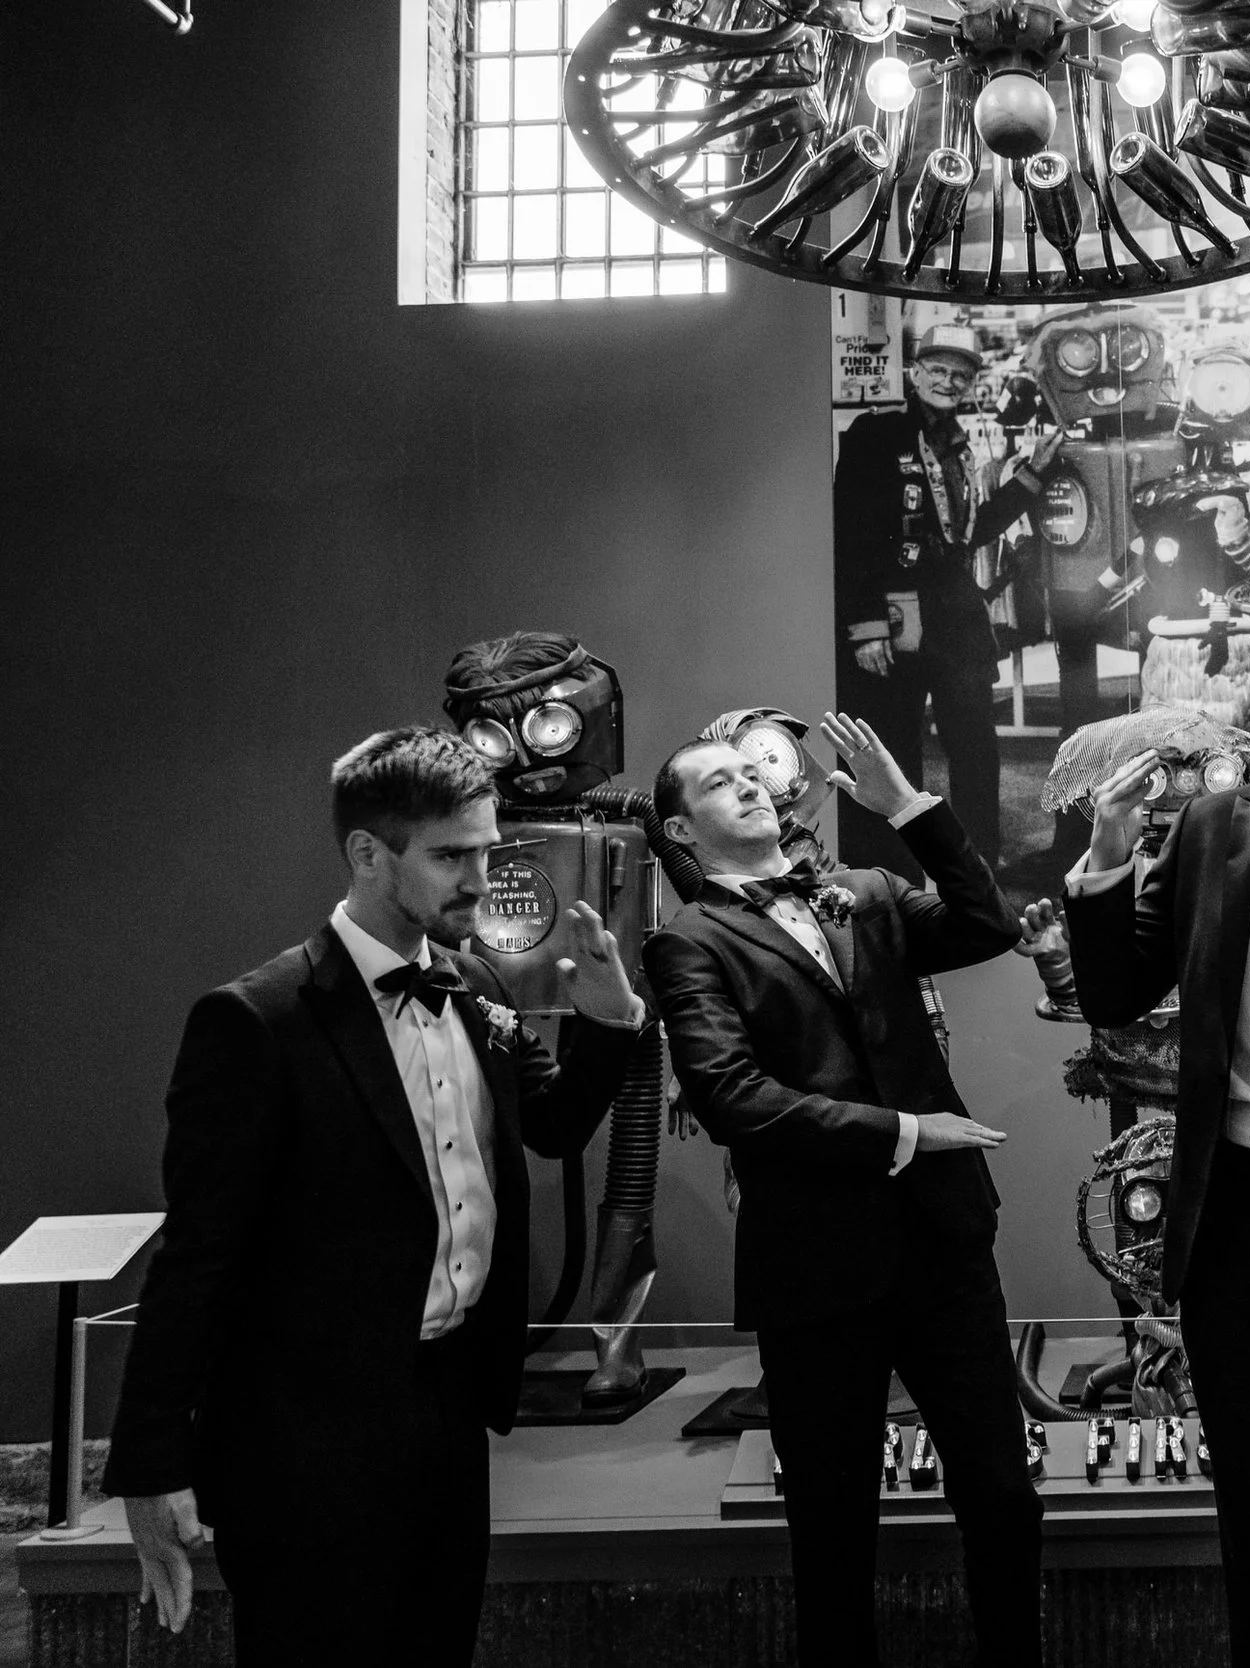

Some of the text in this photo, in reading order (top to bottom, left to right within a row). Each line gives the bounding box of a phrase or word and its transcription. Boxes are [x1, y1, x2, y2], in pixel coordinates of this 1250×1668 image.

[841, 356, 889, 366] FIND IT
[845, 367, 885, 376] HERE!
[512, 870, 532, 879] THIS
[487, 880, 519, 889] AREA IS
[492, 890, 537, 900] FLASHING,
[489, 902, 540, 915] DANGER
